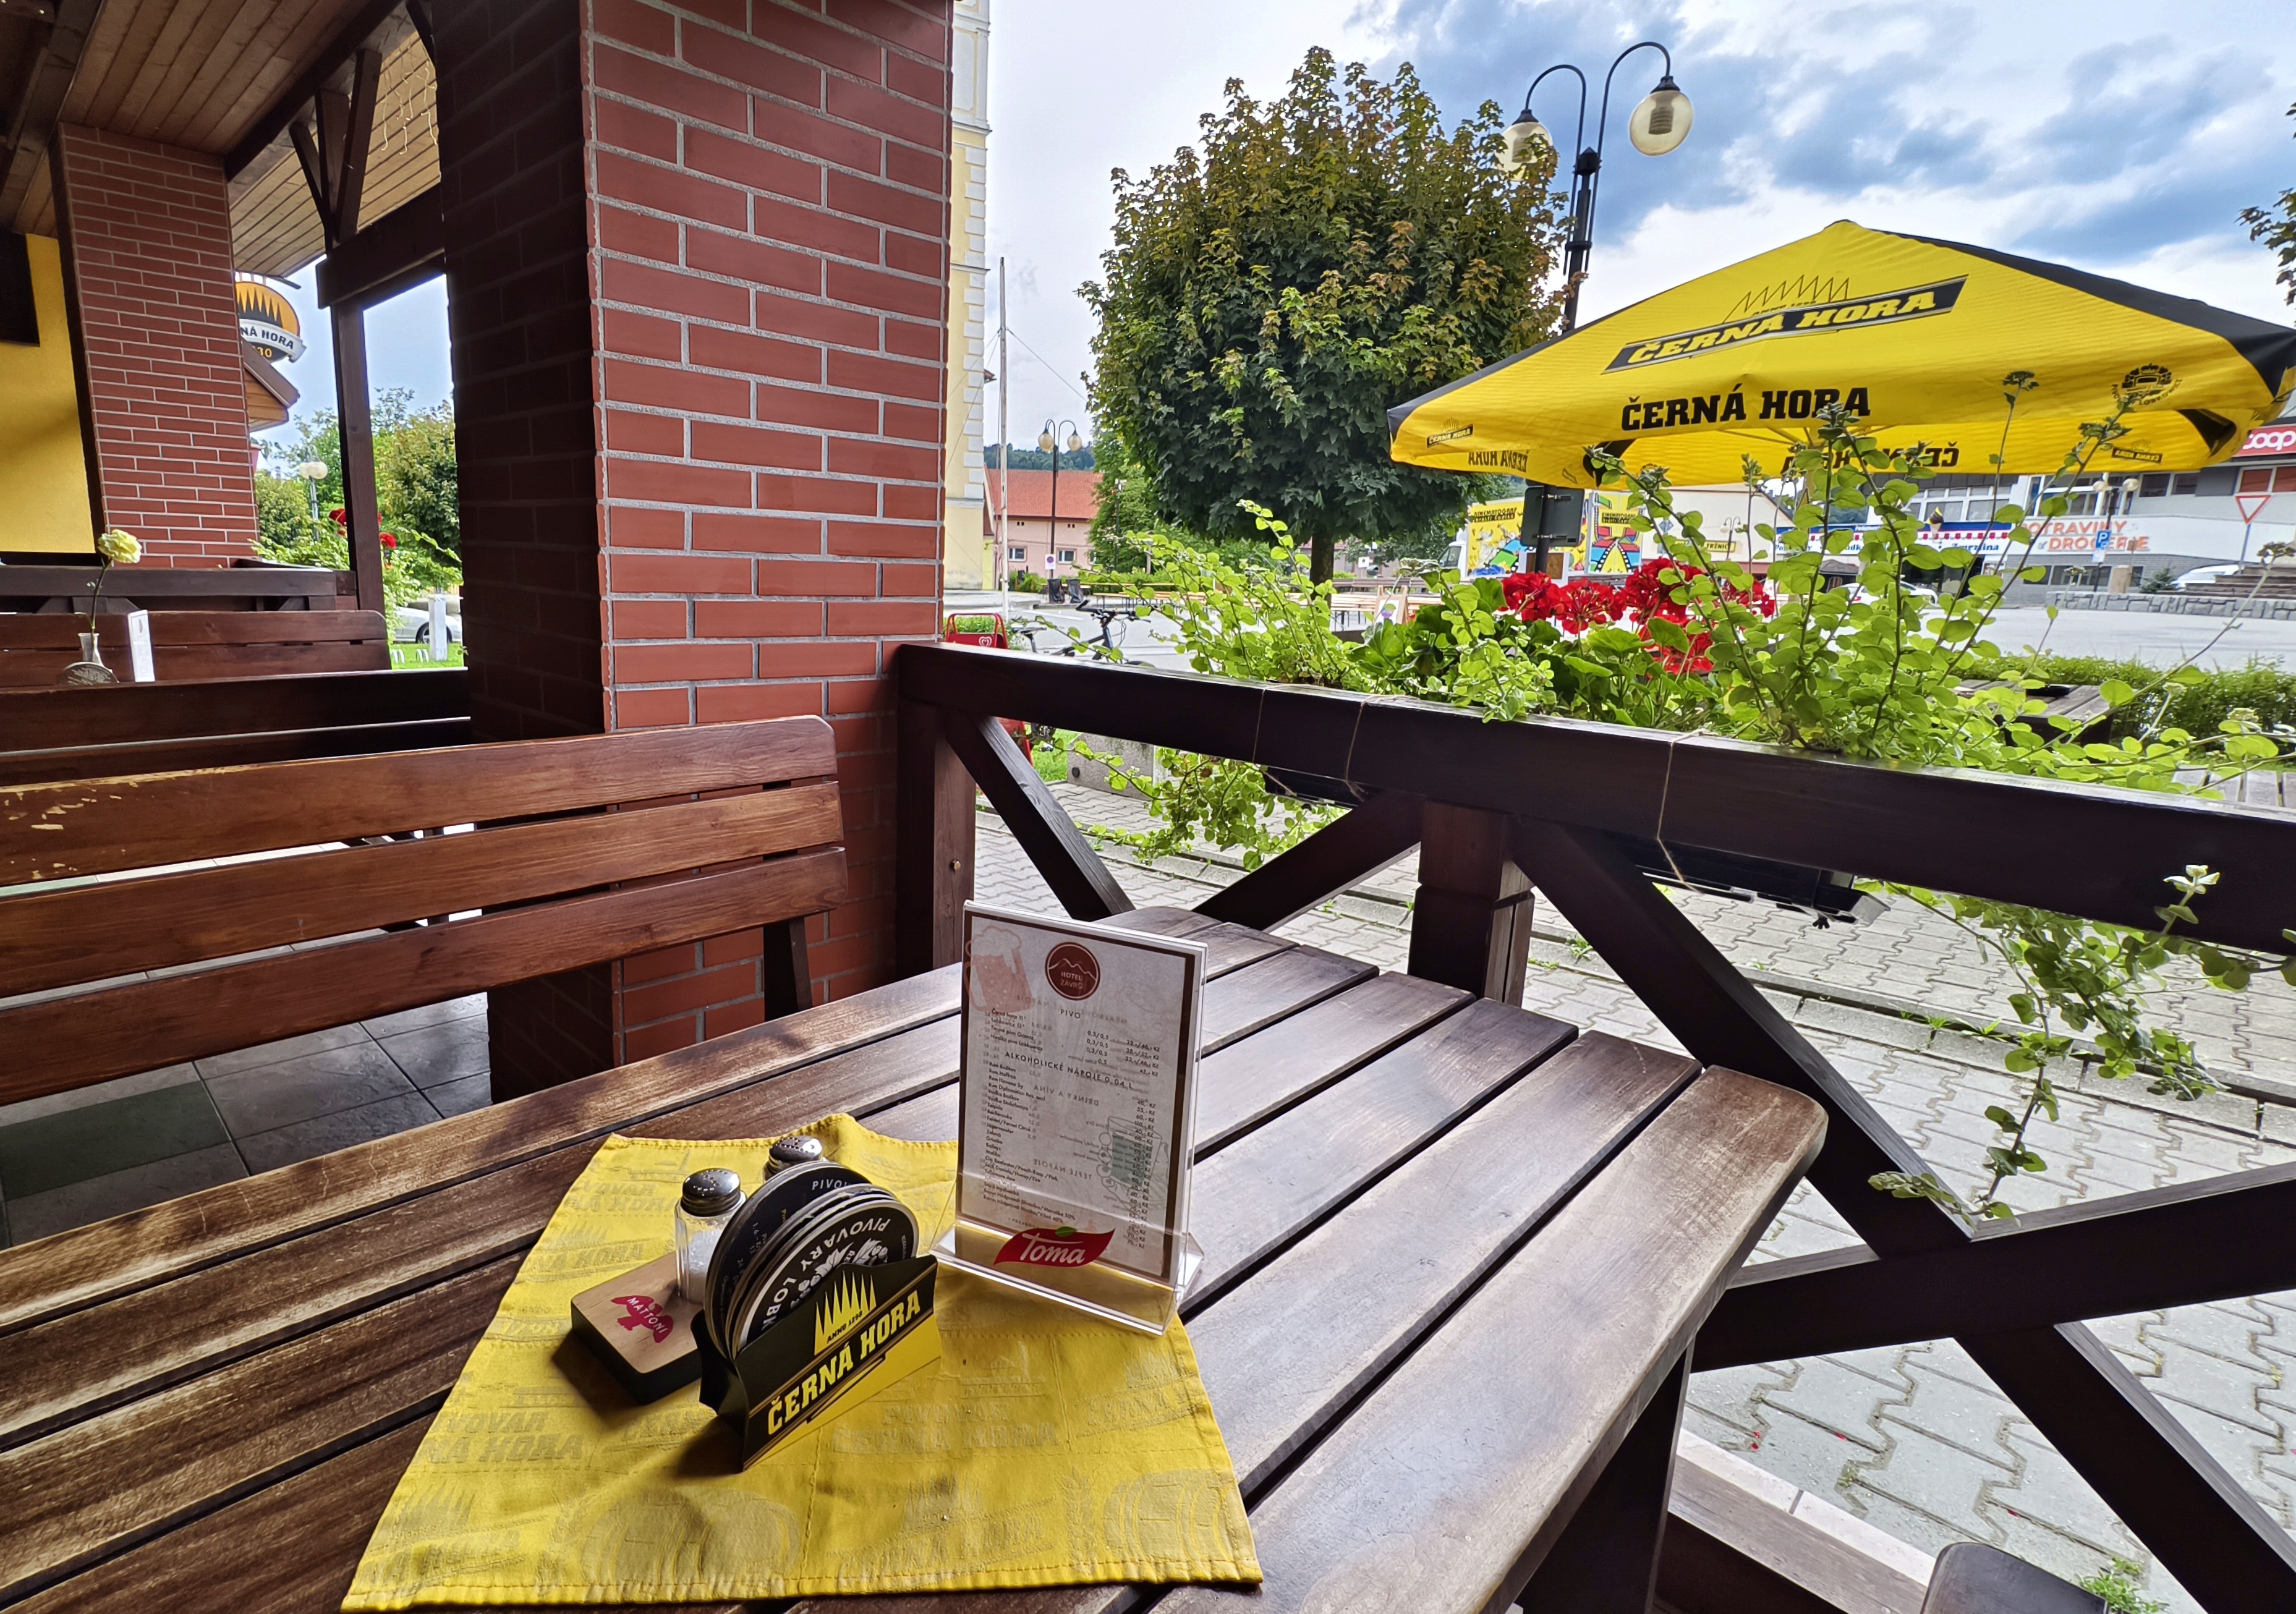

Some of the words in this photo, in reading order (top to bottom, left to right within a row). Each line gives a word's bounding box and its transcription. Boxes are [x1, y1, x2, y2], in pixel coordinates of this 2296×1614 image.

[1796, 292, 1936, 328] HORA
[261, 329, 294, 350] HORA
[1622, 383, 1746, 431] ČERNÁ
[1759, 388, 1871, 421] HORA
[1452, 428, 1471, 439] HORA
[1060, 971, 1083, 982] HOTEL
[1060, 1008, 1081, 1019] PIVO
[1086, 1030, 1108, 1041] 0,3/0,5
[1086, 1038, 1108, 1050] 0,3/0,5
[1005, 1048, 1064, 1072] ALKOHOLICKÉ
[1066, 1064, 1101, 1081] NÁPOJE
[801, 1217, 891, 1272] PIVOVARY
[1019, 1232, 1086, 1265] Toma
[627, 1297, 668, 1333] MATTONI
[827, 1323, 847, 1344] ANNO
[768, 1341, 854, 1435] ČERNÁ
[860, 1289, 921, 1360] HORA
